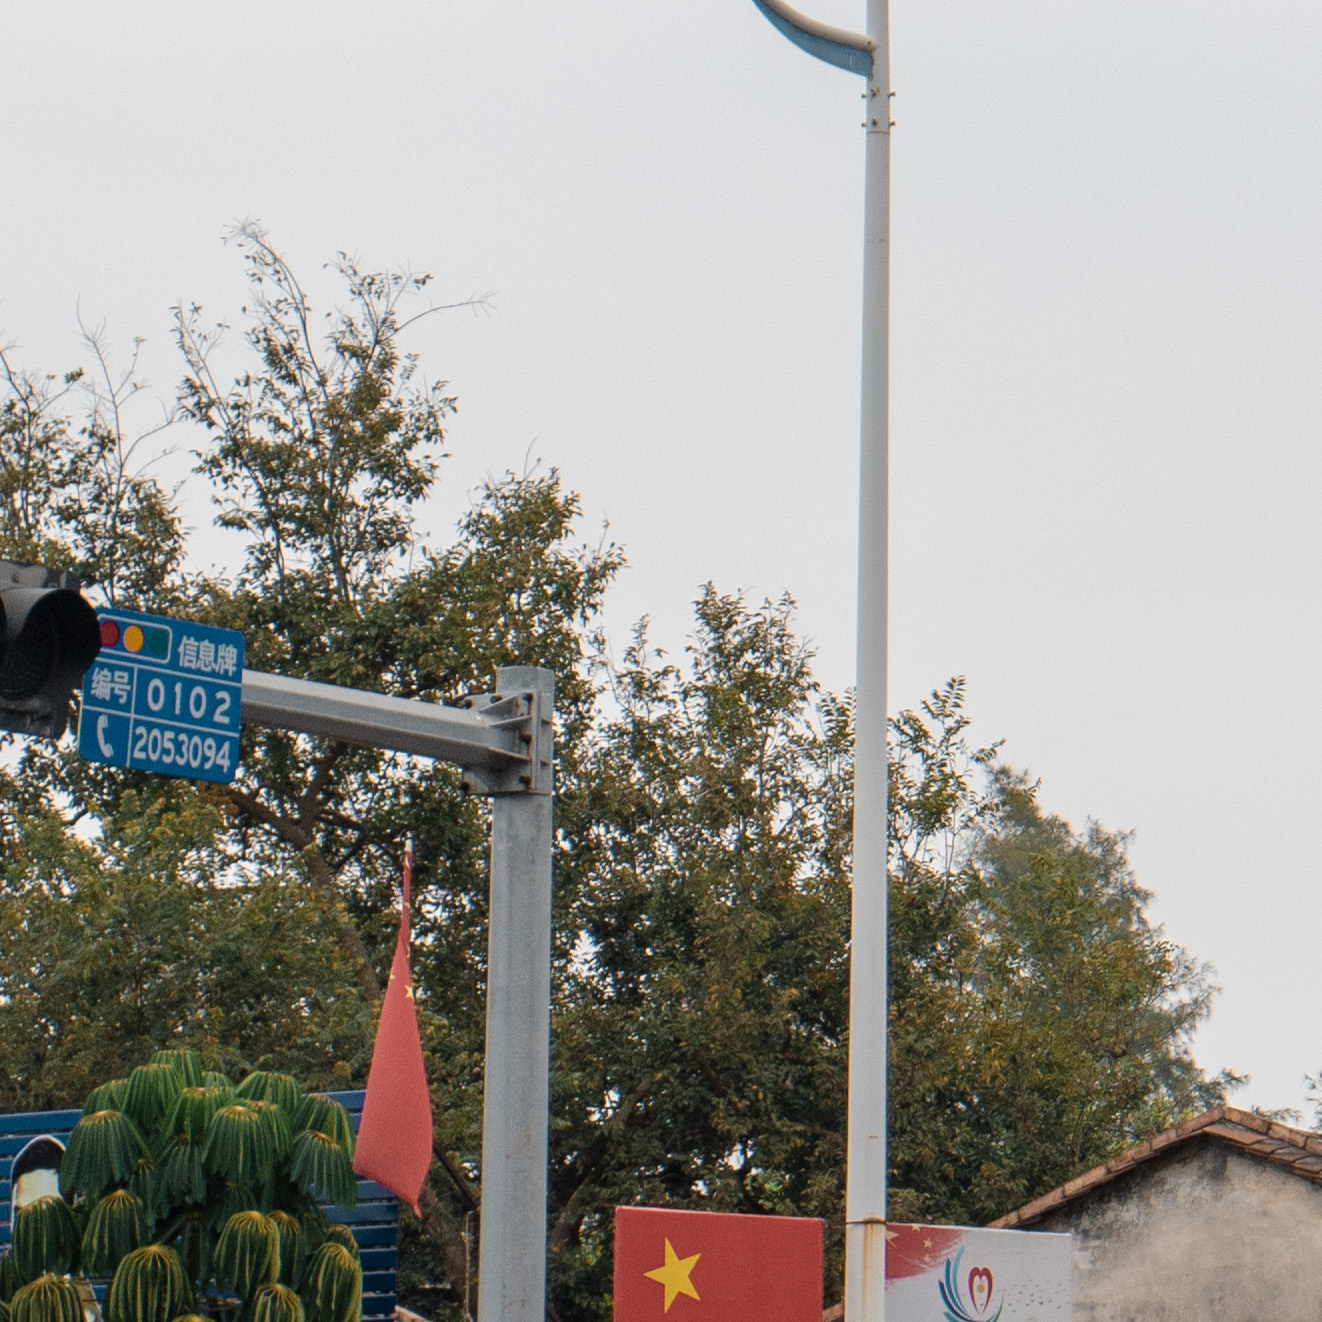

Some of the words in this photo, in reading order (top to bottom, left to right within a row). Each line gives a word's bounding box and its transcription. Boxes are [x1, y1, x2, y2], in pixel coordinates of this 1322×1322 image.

[178, 635, 237, 677] 信息牌
[90, 667, 131, 704] 编号
[147, 678, 231, 724] 0102
[133, 726, 231, 774] 2053094
